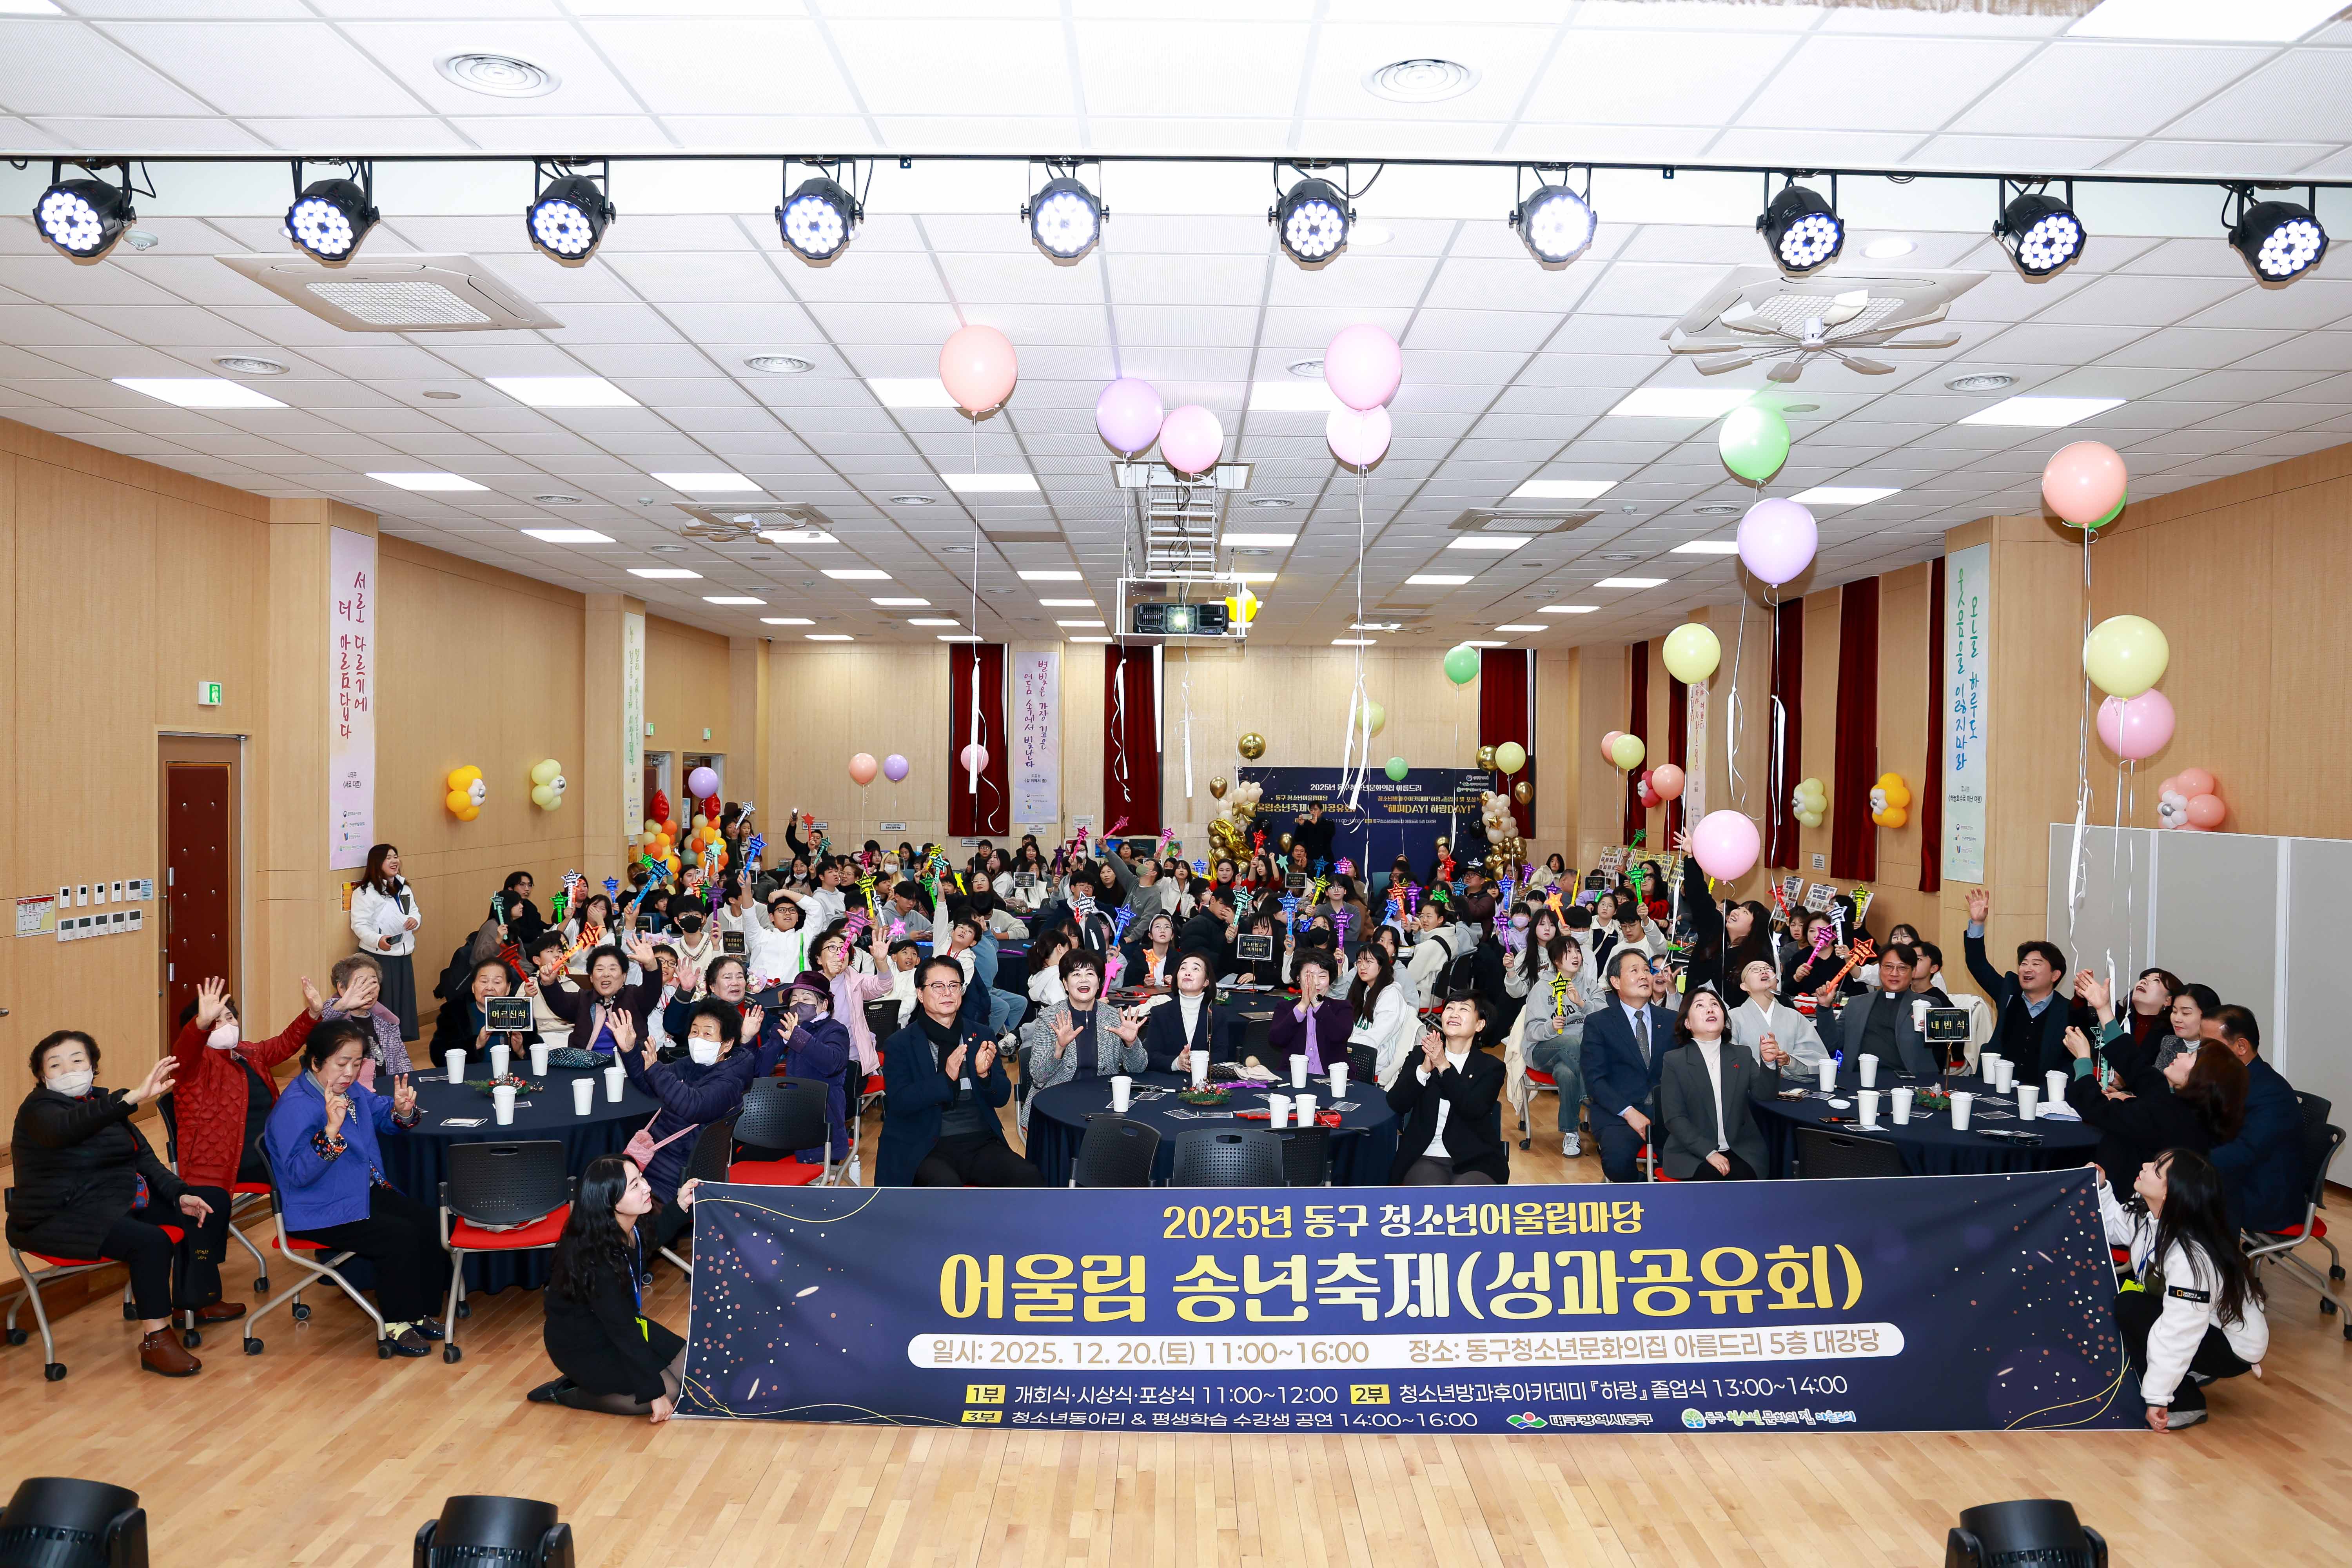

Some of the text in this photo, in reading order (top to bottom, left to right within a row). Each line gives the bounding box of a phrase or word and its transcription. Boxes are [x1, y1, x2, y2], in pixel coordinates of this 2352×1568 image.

[339, 600, 351, 621] 더
[354, 572, 368, 713] 서로 다르기에
[1024, 673, 1033, 695] 어둠
[1024, 699, 1034, 731] 속에서
[1038, 661, 1049, 750] 별빛은 가장 깊은
[492, 1010, 526, 1018] 어르신석
[1931, 1020, 1964, 1029] 내빈석
[1163, 1201, 1645, 1239] 2025년 동구 청소년어울림마당
[940, 1244, 1863, 1323] 어울림 송년축제(성과공유회)
[933, 1328, 1880, 1365] 일시: 2025. 12. 20.(토) 11:00~16:00 장소: 동구청소년문화의집 아름드리 5층 대강당
[973, 1387, 999, 1403] 1부
[1014, 1386, 1195, 1405] 개회식·시상식·포상식
[1202, 1387, 1338, 1404] 11:00~12:00
[1355, 1387, 1384, 1403] 2부
[1399, 1381, 1587, 1403] 청소년방과후아카데미
[1651, 1378, 1707, 1399] 졸업식
[1712, 1376, 1847, 1397] 13:00~14:00
[966, 1411, 1478, 1428] 3부 청소년동아리 & 평생학습 수강생 공연 14:00~16:00
[1549, 1414, 1653, 1427] 대구광역시동구
[1705, 1412, 1726, 1424] 동구
[1726, 1409, 1765, 1426] 청소년
